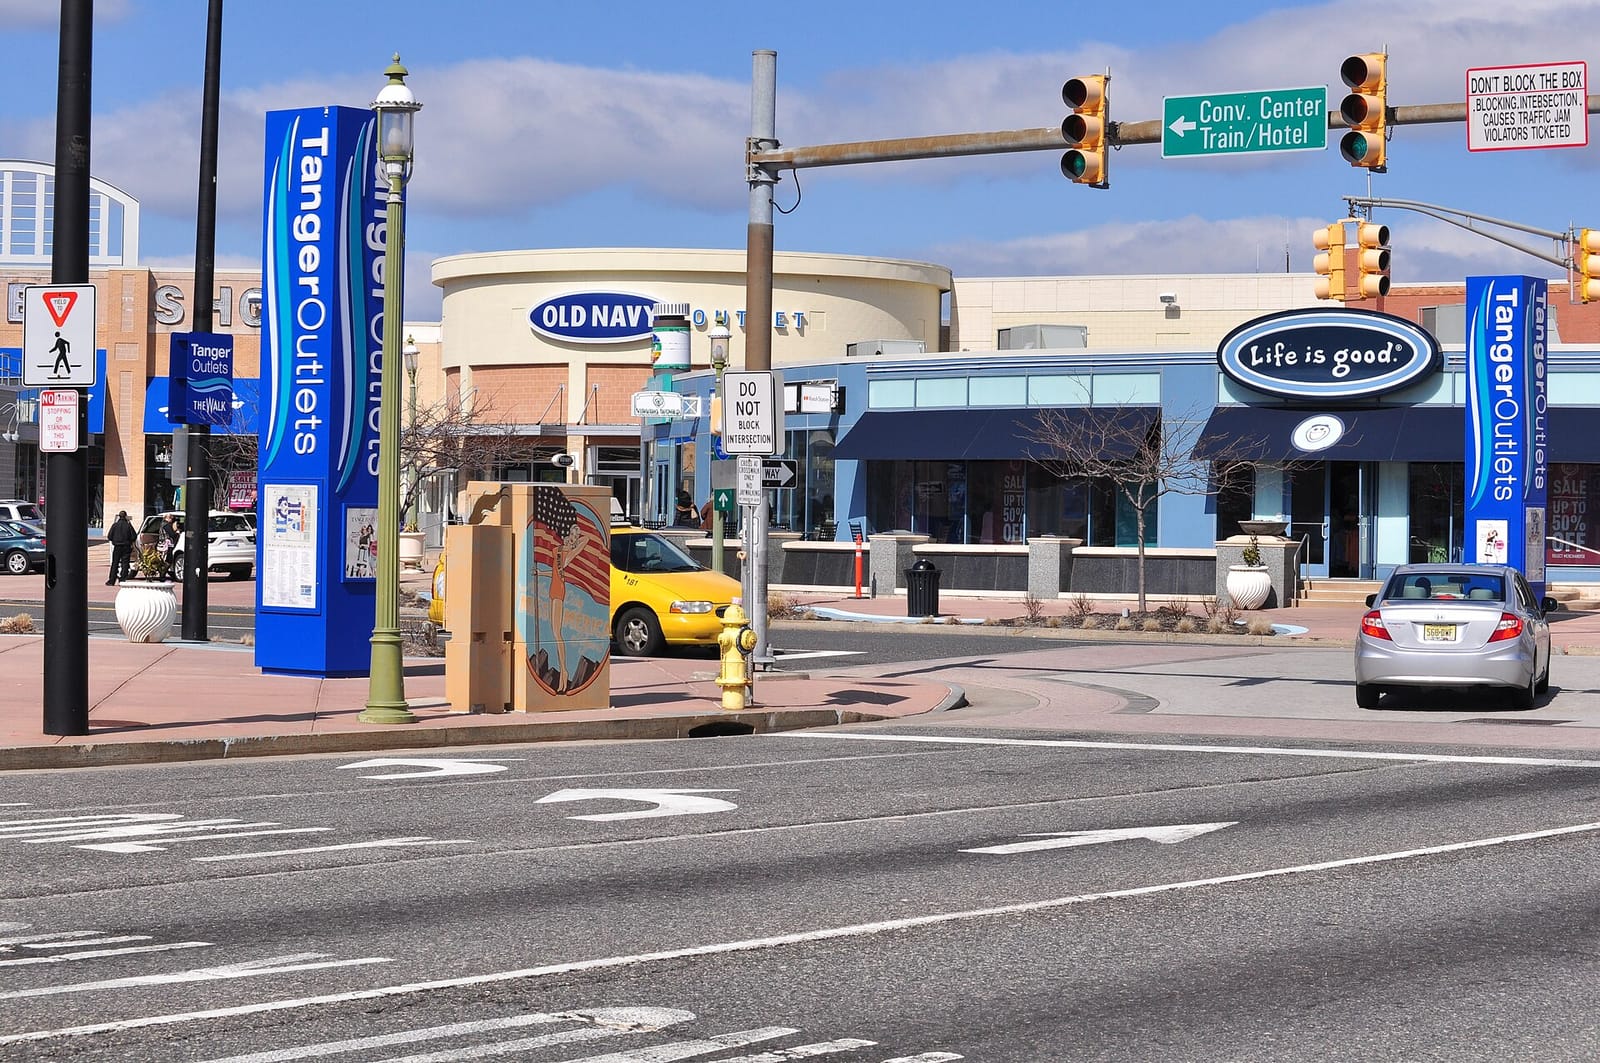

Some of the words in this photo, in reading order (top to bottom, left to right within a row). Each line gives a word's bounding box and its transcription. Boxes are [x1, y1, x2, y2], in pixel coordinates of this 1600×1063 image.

[1471, 76, 1500, 93] DON'T
[1503, 74, 1536, 91] BLOCK
[1539, 72, 1558, 89] THE
[1562, 71, 1582, 88] BOX
[1200, 100, 1251, 123] Conv.
[1260, 96, 1322, 119] Center
[1483, 111, 1515, 126] CAUSES
[1518, 109, 1551, 125] TRAFFIC
[1554, 108, 1571, 122] JAM
[1200, 121, 1307, 149] Train/Hotel
[1484, 126, 1528, 142] VIOLATORS
[1531, 124, 1570, 139] TICKETED
[542, 305, 587, 328] OLD
[591, 305, 654, 328] NAVY
[693, 310, 805, 329] OUTET
[191, 343, 232, 360] Tanger
[1250, 342, 1298, 367] Life
[1304, 346, 1326, 364] is
[192, 359, 229, 374] Outlets
[739, 381, 757, 397] DO
[1489, 288, 1519, 501] TangerOutlets
[42, 394, 54, 404] NO
[736, 401, 761, 416] NOT
[738, 420, 760, 430] BLOCK
[727, 434, 771, 444] INTERSECTION
[765, 468, 780, 479] WAY
[1552, 480, 1587, 494] SALE
[1003, 494, 1015, 506] UP
[1552, 501, 1569, 514] UP
[1571, 501, 1586, 514] TO
[1552, 514, 1586, 532] 50%
[1552, 531, 1586, 553] OFF
